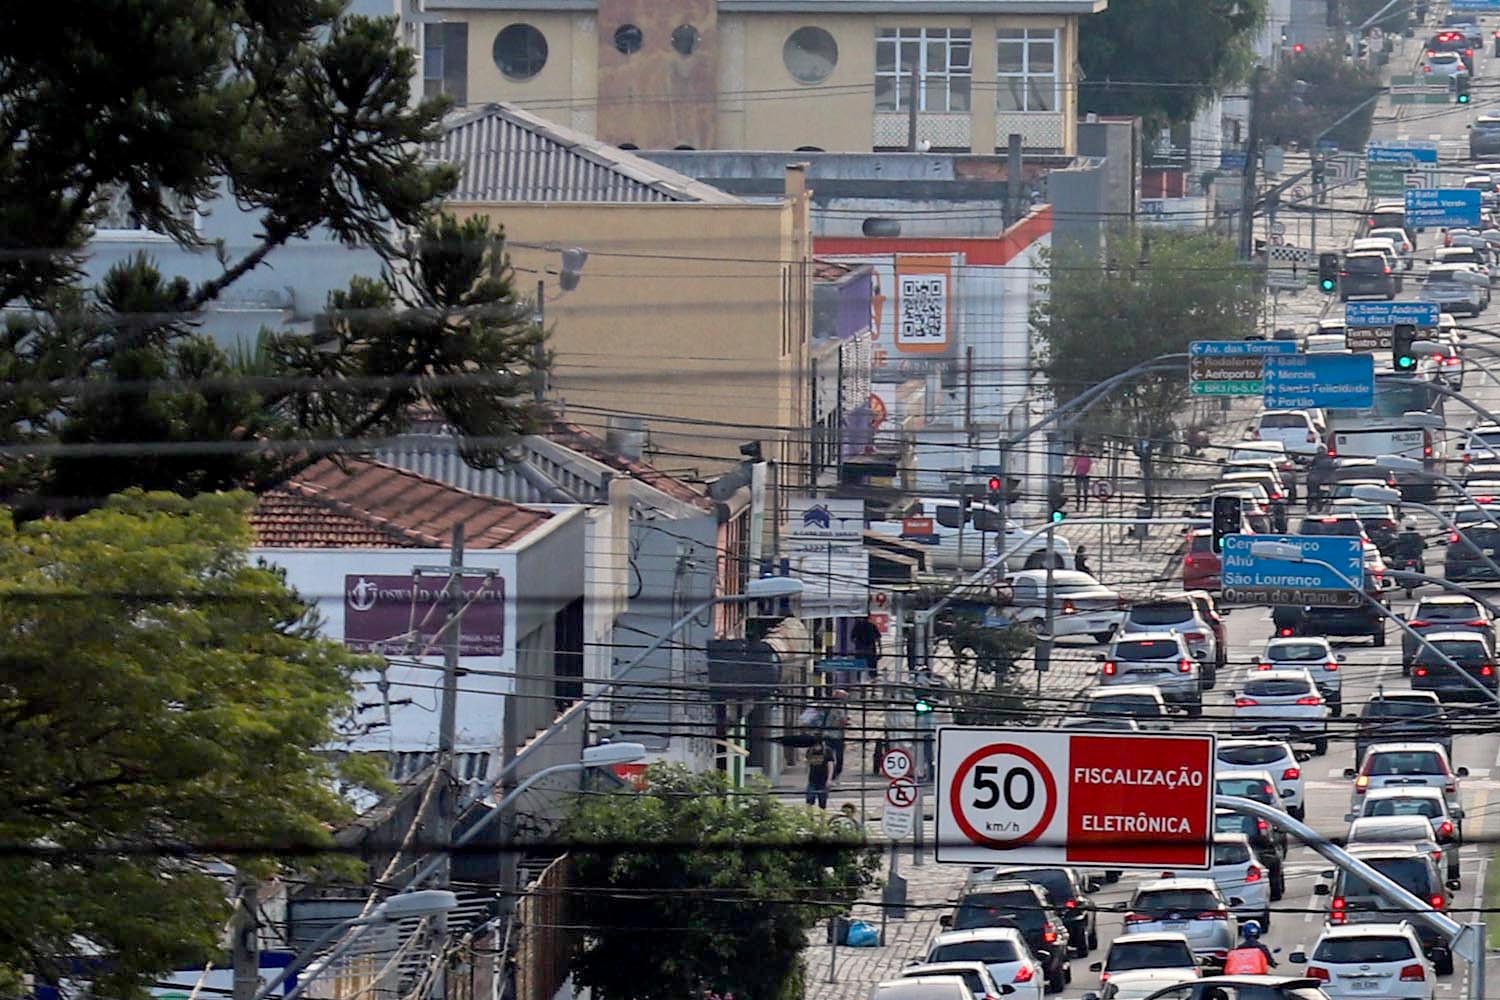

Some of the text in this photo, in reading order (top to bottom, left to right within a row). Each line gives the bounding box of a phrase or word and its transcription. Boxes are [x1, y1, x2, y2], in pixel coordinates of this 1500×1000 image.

[1368, 314, 1386, 324] das
[1205, 344, 1281, 353] Av. das Torres
[1313, 383, 1369, 393] Felicidade
[1225, 555, 1254, 567] Ahú
[1225, 572, 1322, 586] São Lourenço
[887, 756, 907, 769] 50
[1074, 766, 1203, 790] FISCALIZAÇÃO
[972, 765, 1035, 811] 50
[985, 820, 1020, 832] km/h
[1082, 811, 1191, 833] ELETRÔNICA
